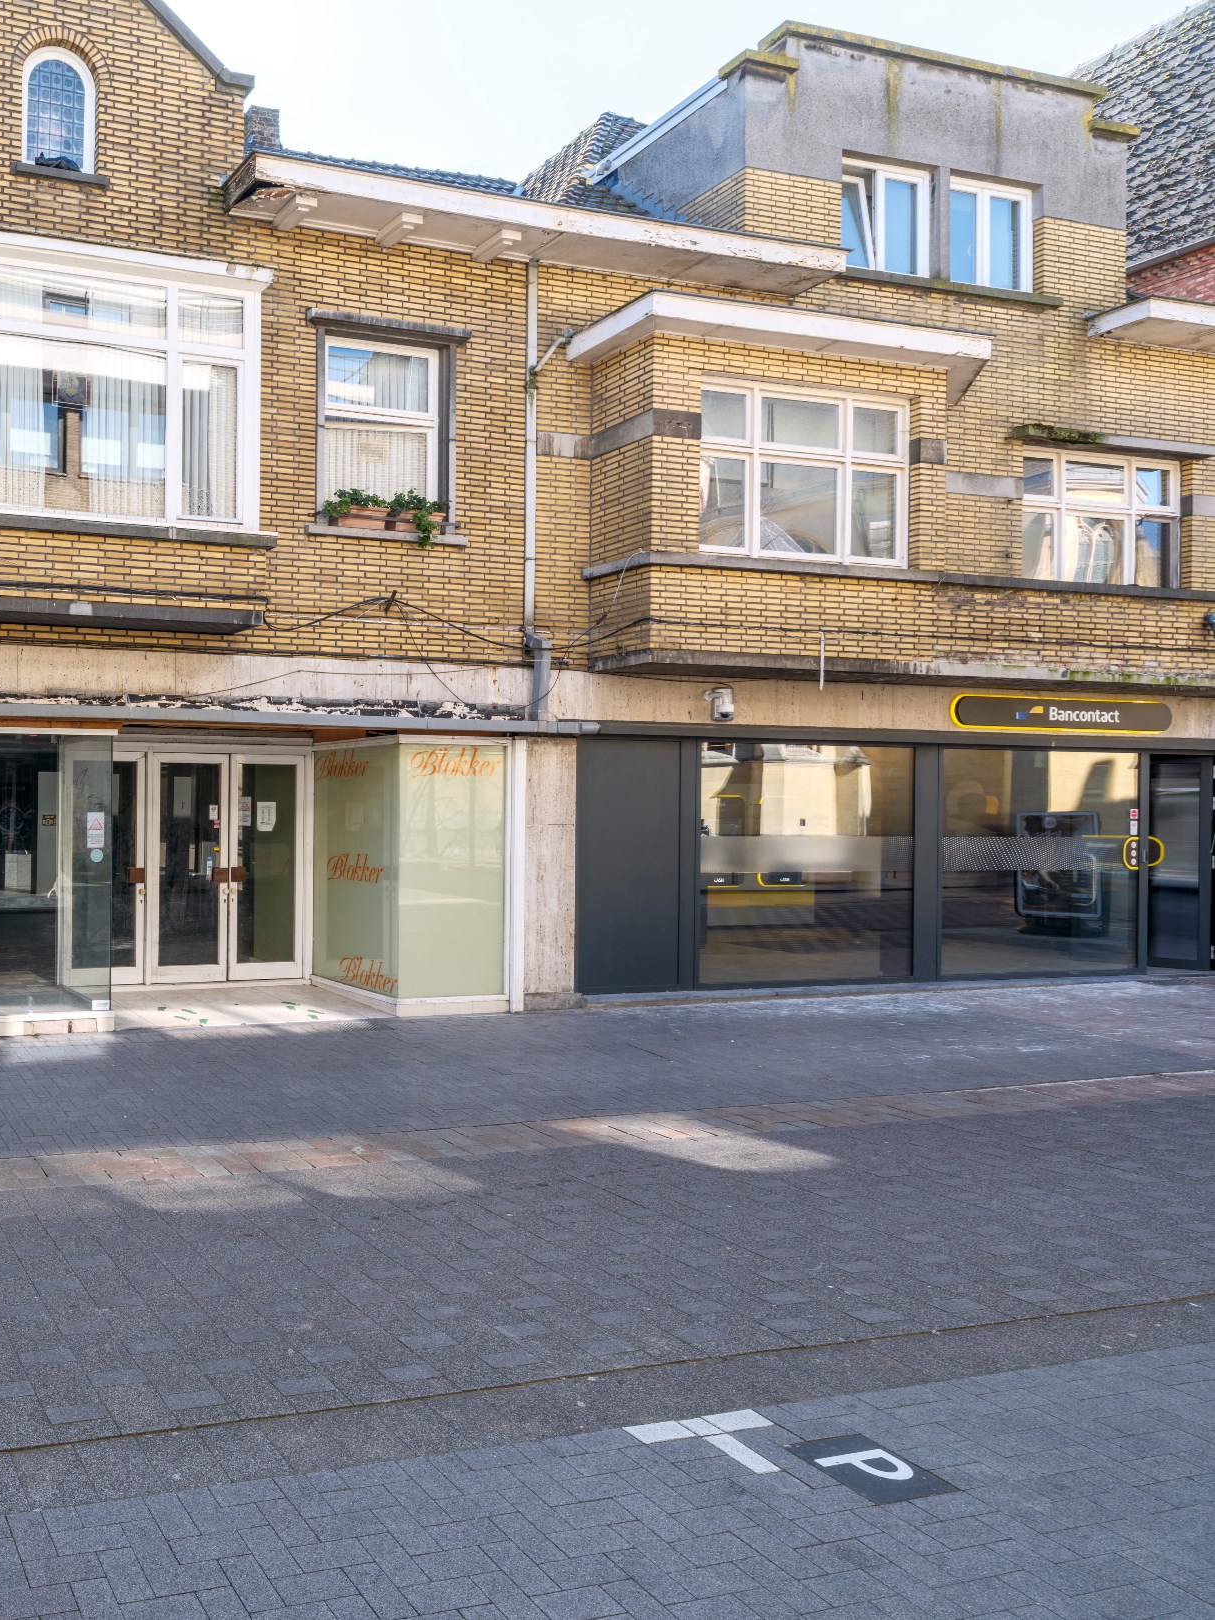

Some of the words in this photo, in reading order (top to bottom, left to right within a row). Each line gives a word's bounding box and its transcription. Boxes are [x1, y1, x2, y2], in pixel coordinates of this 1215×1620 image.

[1049, 706, 1120, 723] Bancontact
[315, 749, 369, 781] Blokker
[410, 747, 501, 779] Blokker
[326, 852, 384, 884] Blokker
[339, 956, 398, 994] Blokker
